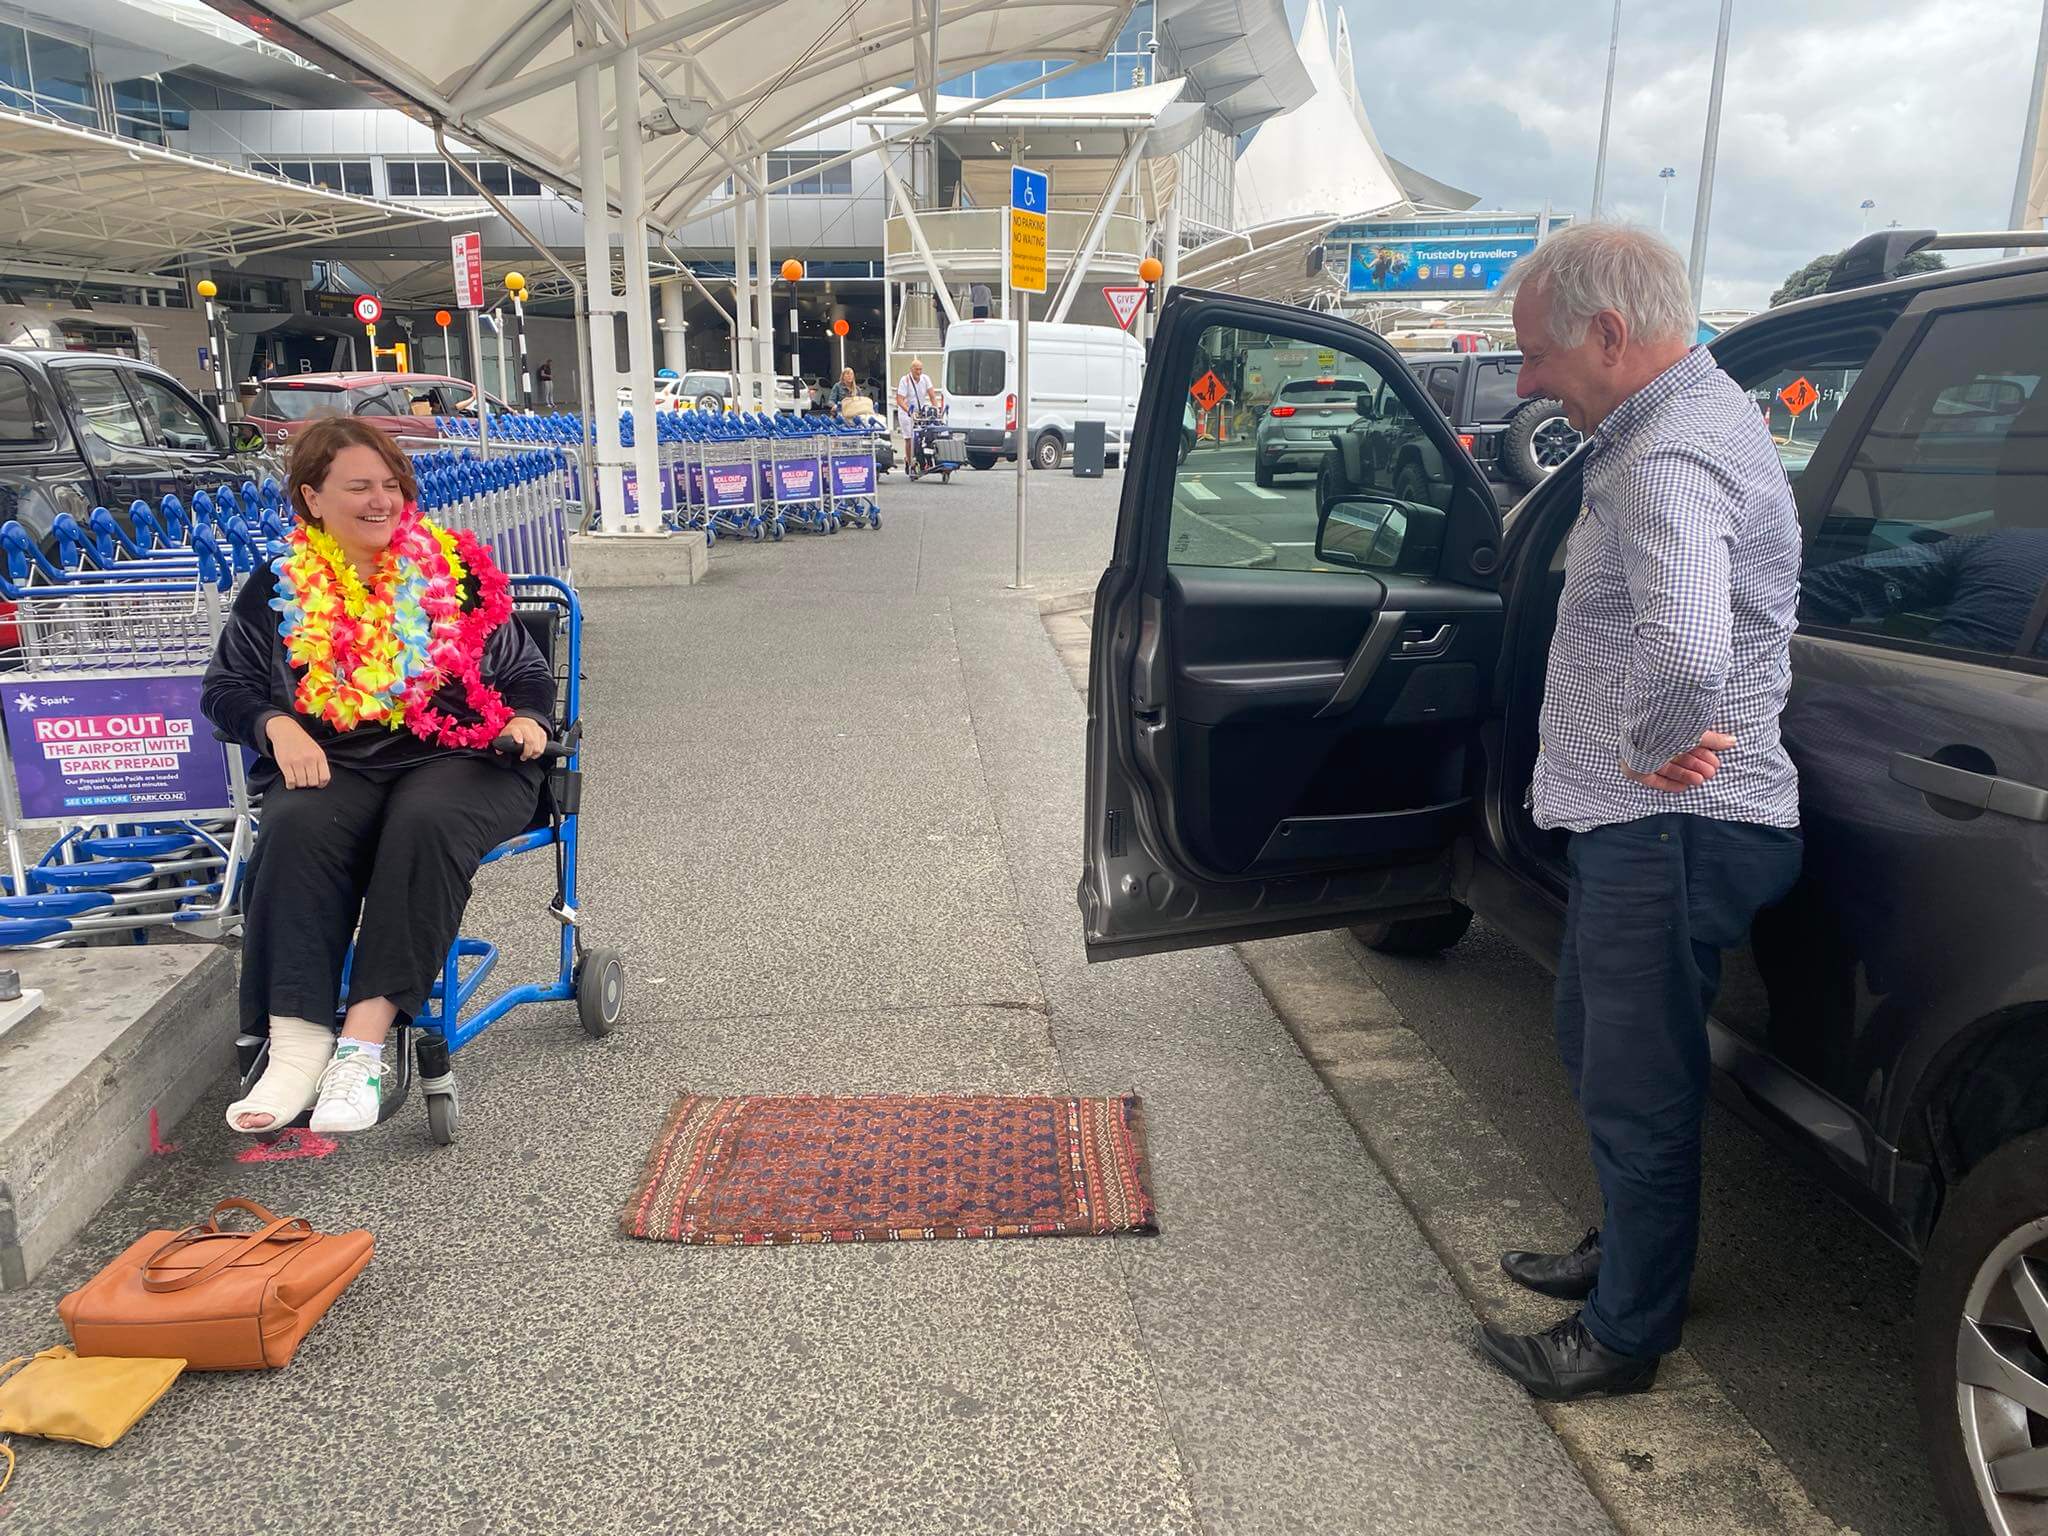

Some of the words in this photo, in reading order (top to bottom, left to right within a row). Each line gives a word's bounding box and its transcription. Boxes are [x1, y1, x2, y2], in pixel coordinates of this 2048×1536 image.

[1013, 216, 1021, 227] NO
[1022, 217, 1044, 232] PARKING
[1013, 232, 1021, 243] NO
[1022, 234, 1044, 248] WAITING
[1416, 250, 1455, 260] Trusted
[1456, 249, 1468, 261] by
[1470, 249, 1518, 259] travellers
[1116, 295, 1135, 305] GIVE
[362, 304, 374, 315] 10
[300, 359, 312, 374] B
[40, 695, 70, 706] Spark
[37, 719, 103, 740] ROLL
[105, 716, 161, 737] OUT
[168, 722, 189, 733] OF
[47, 744, 75, 756] THE
[78, 741, 141, 755] AIRPORT
[148, 739, 186, 752] WITH
[64, 760, 111, 772] SPARK
[115, 757, 176, 769] PREPAID
[80, 776, 105, 785] Prepaid
[106, 775, 124, 783] Value
[65, 798, 80, 806] SEE
[82, 797, 93, 805] US
[95, 794, 129, 803] INSTORE
[131, 792, 184, 802] SPARK.CO.NZ
